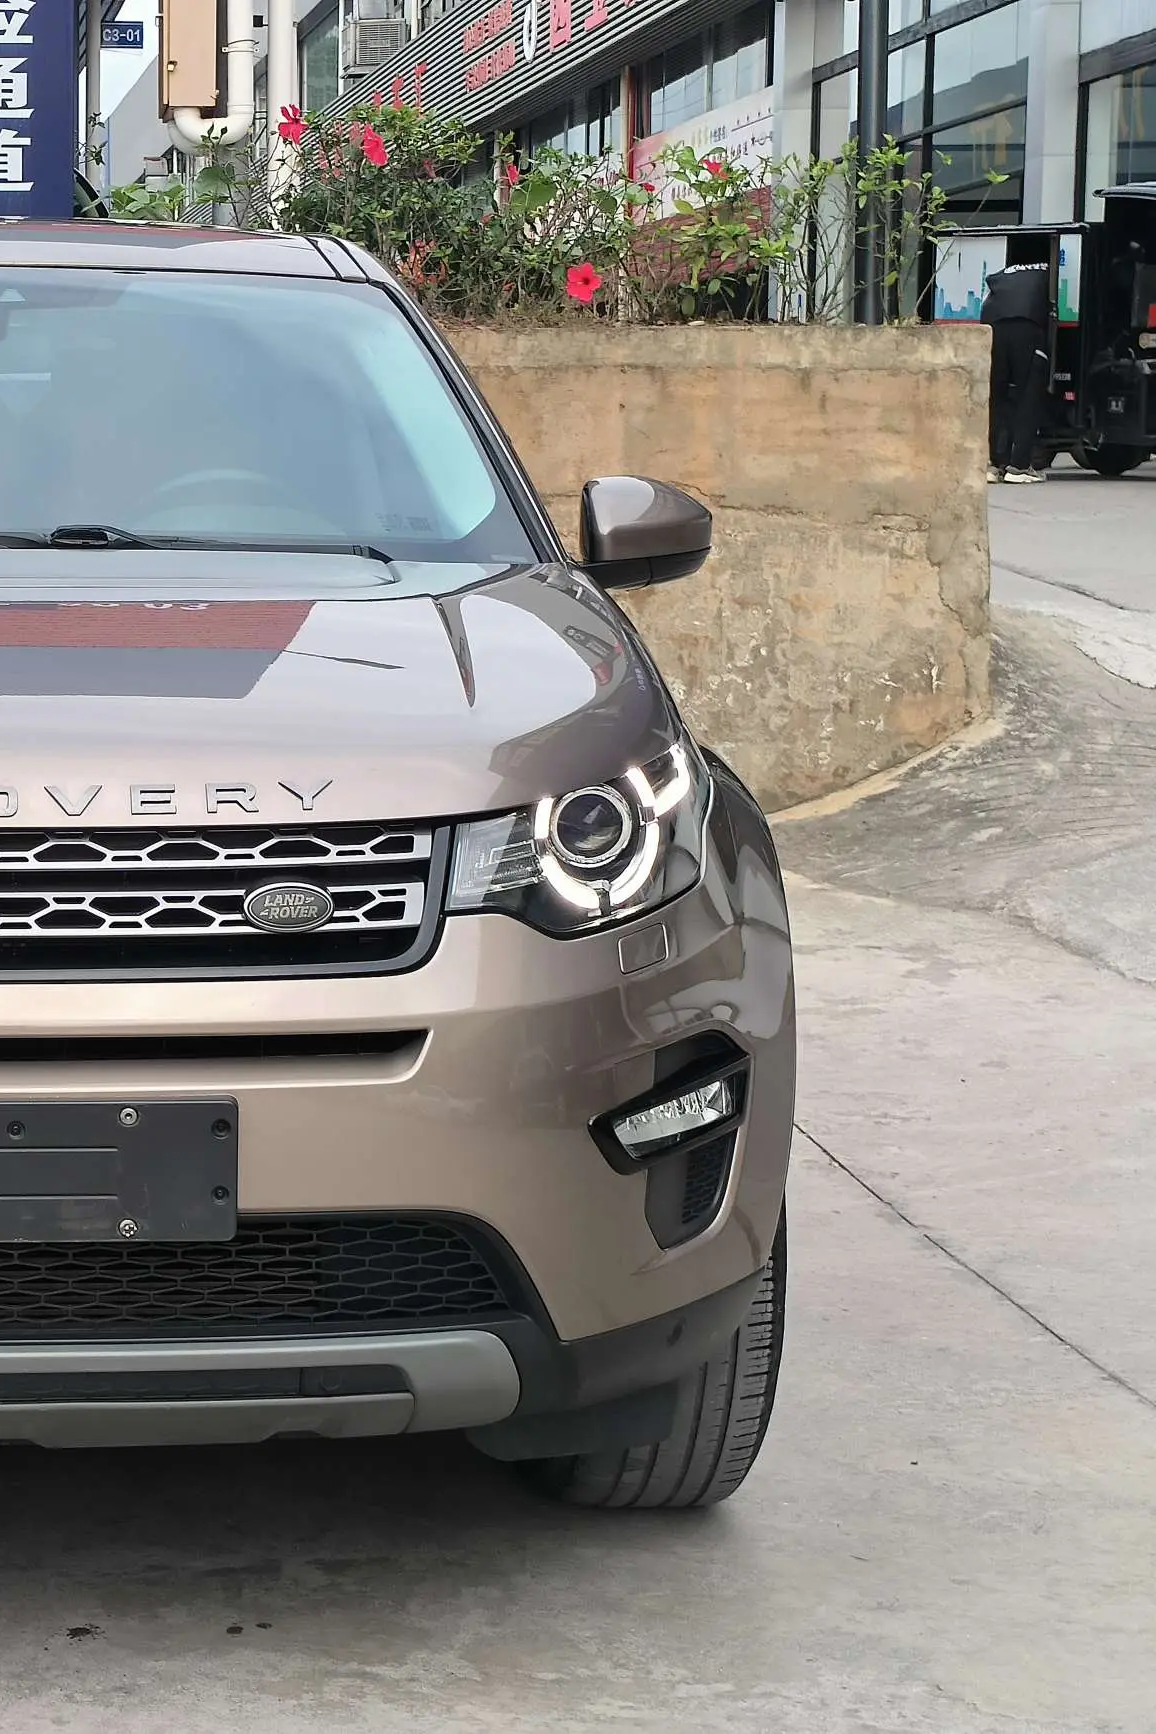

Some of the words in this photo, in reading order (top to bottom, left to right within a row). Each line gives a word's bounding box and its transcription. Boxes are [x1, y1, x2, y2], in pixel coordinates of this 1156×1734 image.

[102, 28, 140, 42] C3-01
[264, 893, 304, 907] LAND
[269, 905, 319, 920] ROVER
